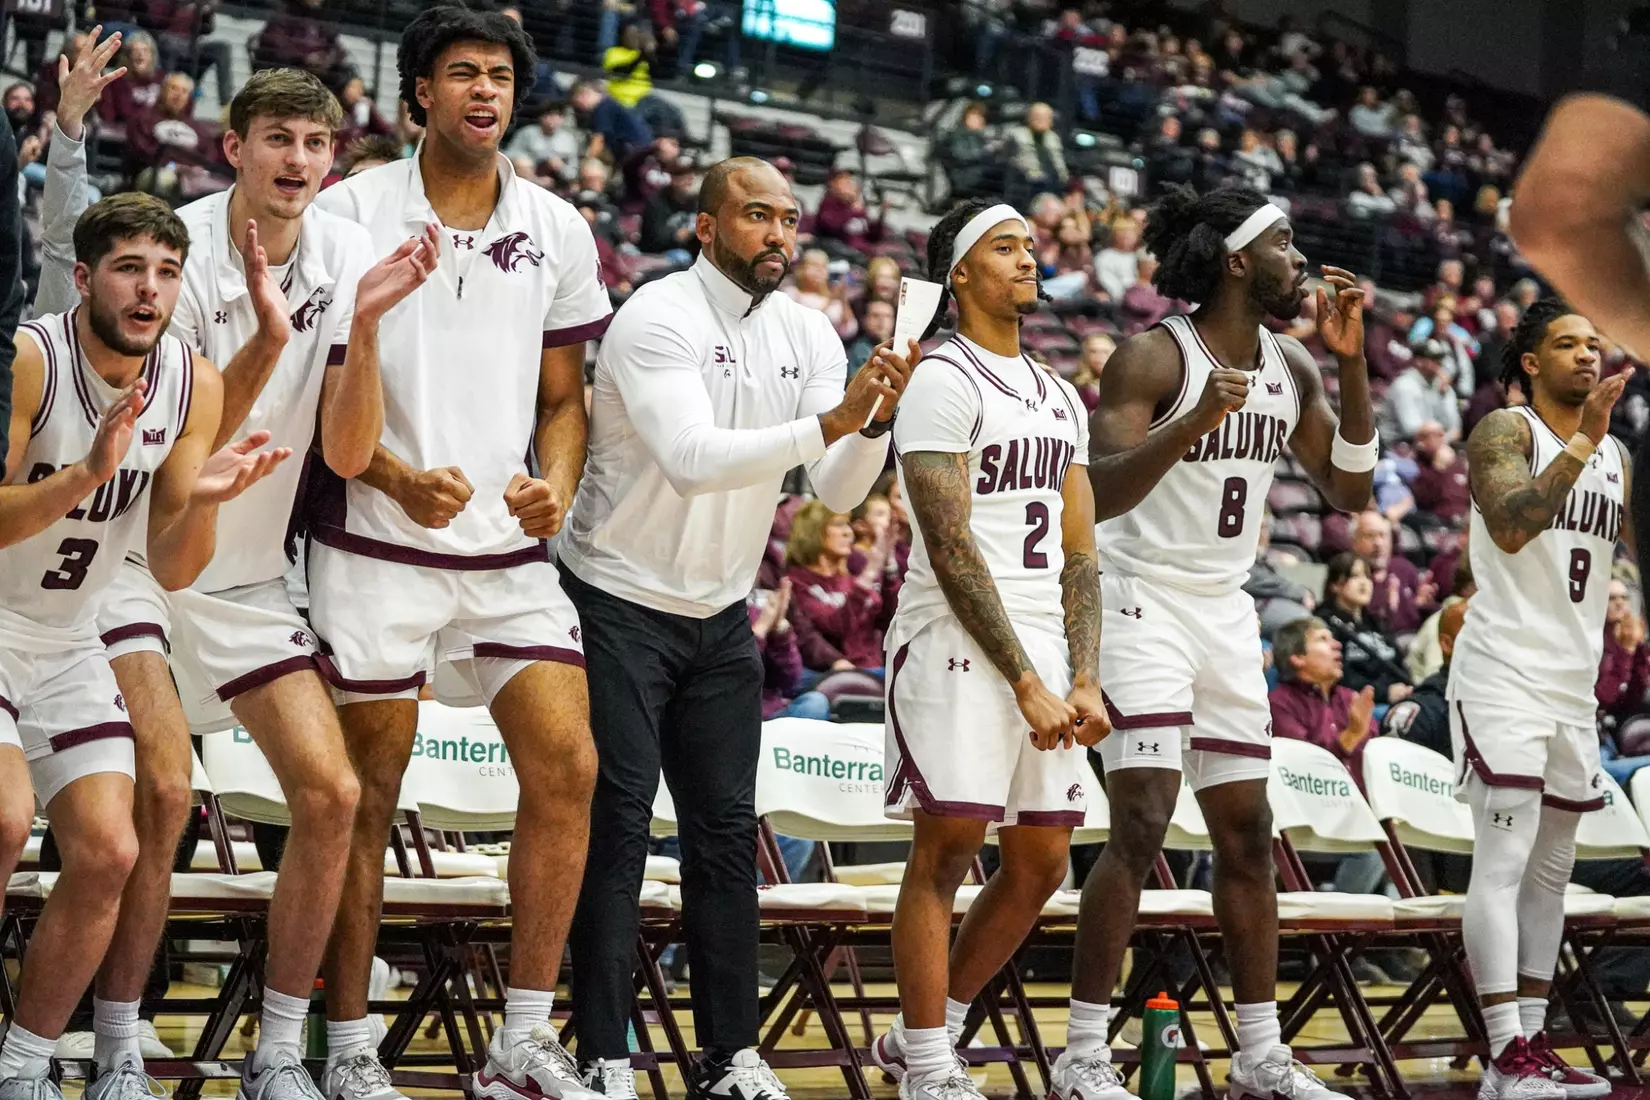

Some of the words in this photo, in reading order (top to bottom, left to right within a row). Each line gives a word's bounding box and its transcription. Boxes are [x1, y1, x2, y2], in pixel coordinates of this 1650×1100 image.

[1022, 500, 1049, 569] 2
[1217, 476, 1248, 538] 8
[1545, 487, 1625, 545] ALUKIS
[40, 537, 99, 590] 3
[1569, 547, 1592, 603] 9
[773, 747, 884, 781] Banterra
[1278, 766, 1350, 797] Banterra
